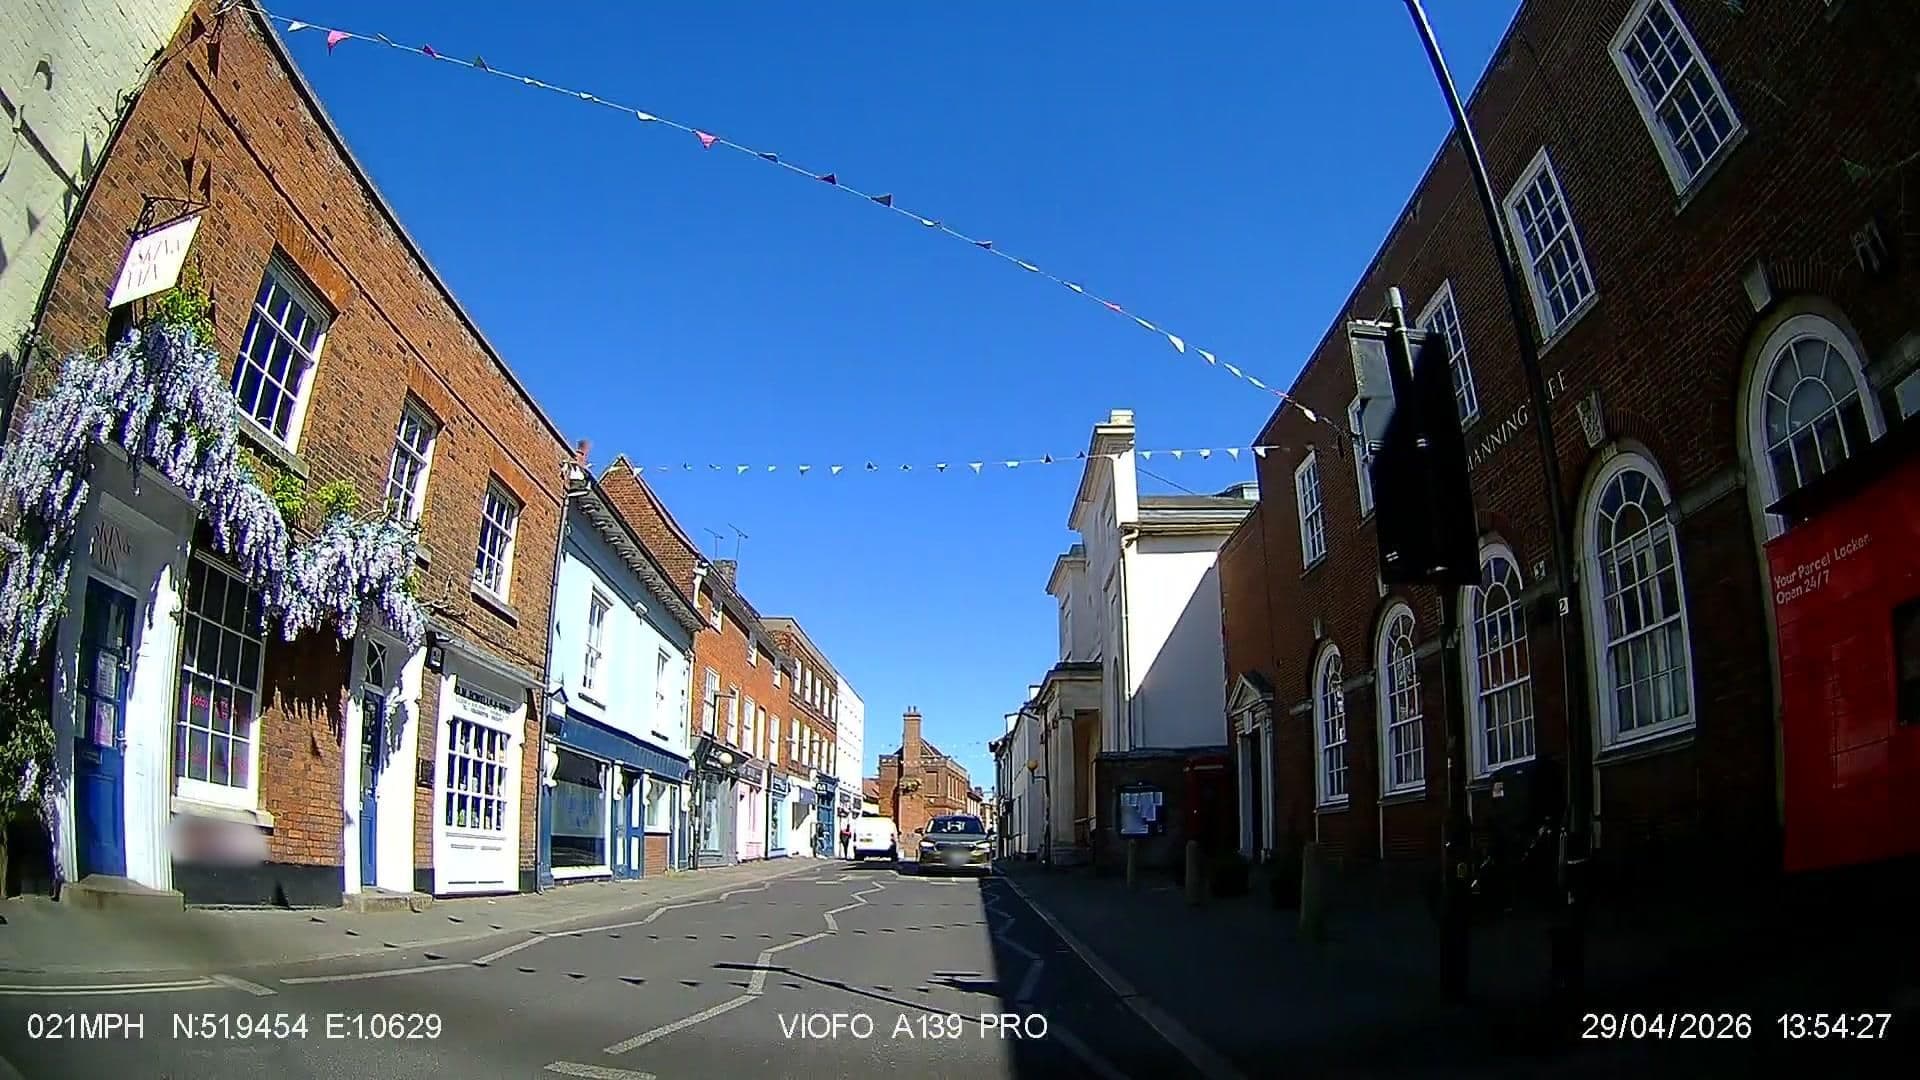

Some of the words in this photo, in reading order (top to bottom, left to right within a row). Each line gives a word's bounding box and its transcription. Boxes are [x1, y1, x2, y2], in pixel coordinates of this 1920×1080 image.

[1465, 370, 1567, 473] ANNINGEE
[1774, 571, 1797, 589] Your
[1798, 552, 1831, 579] Parcel
[1776, 585, 1803, 605] Open
[1803, 569, 1830, 592] 24/7
